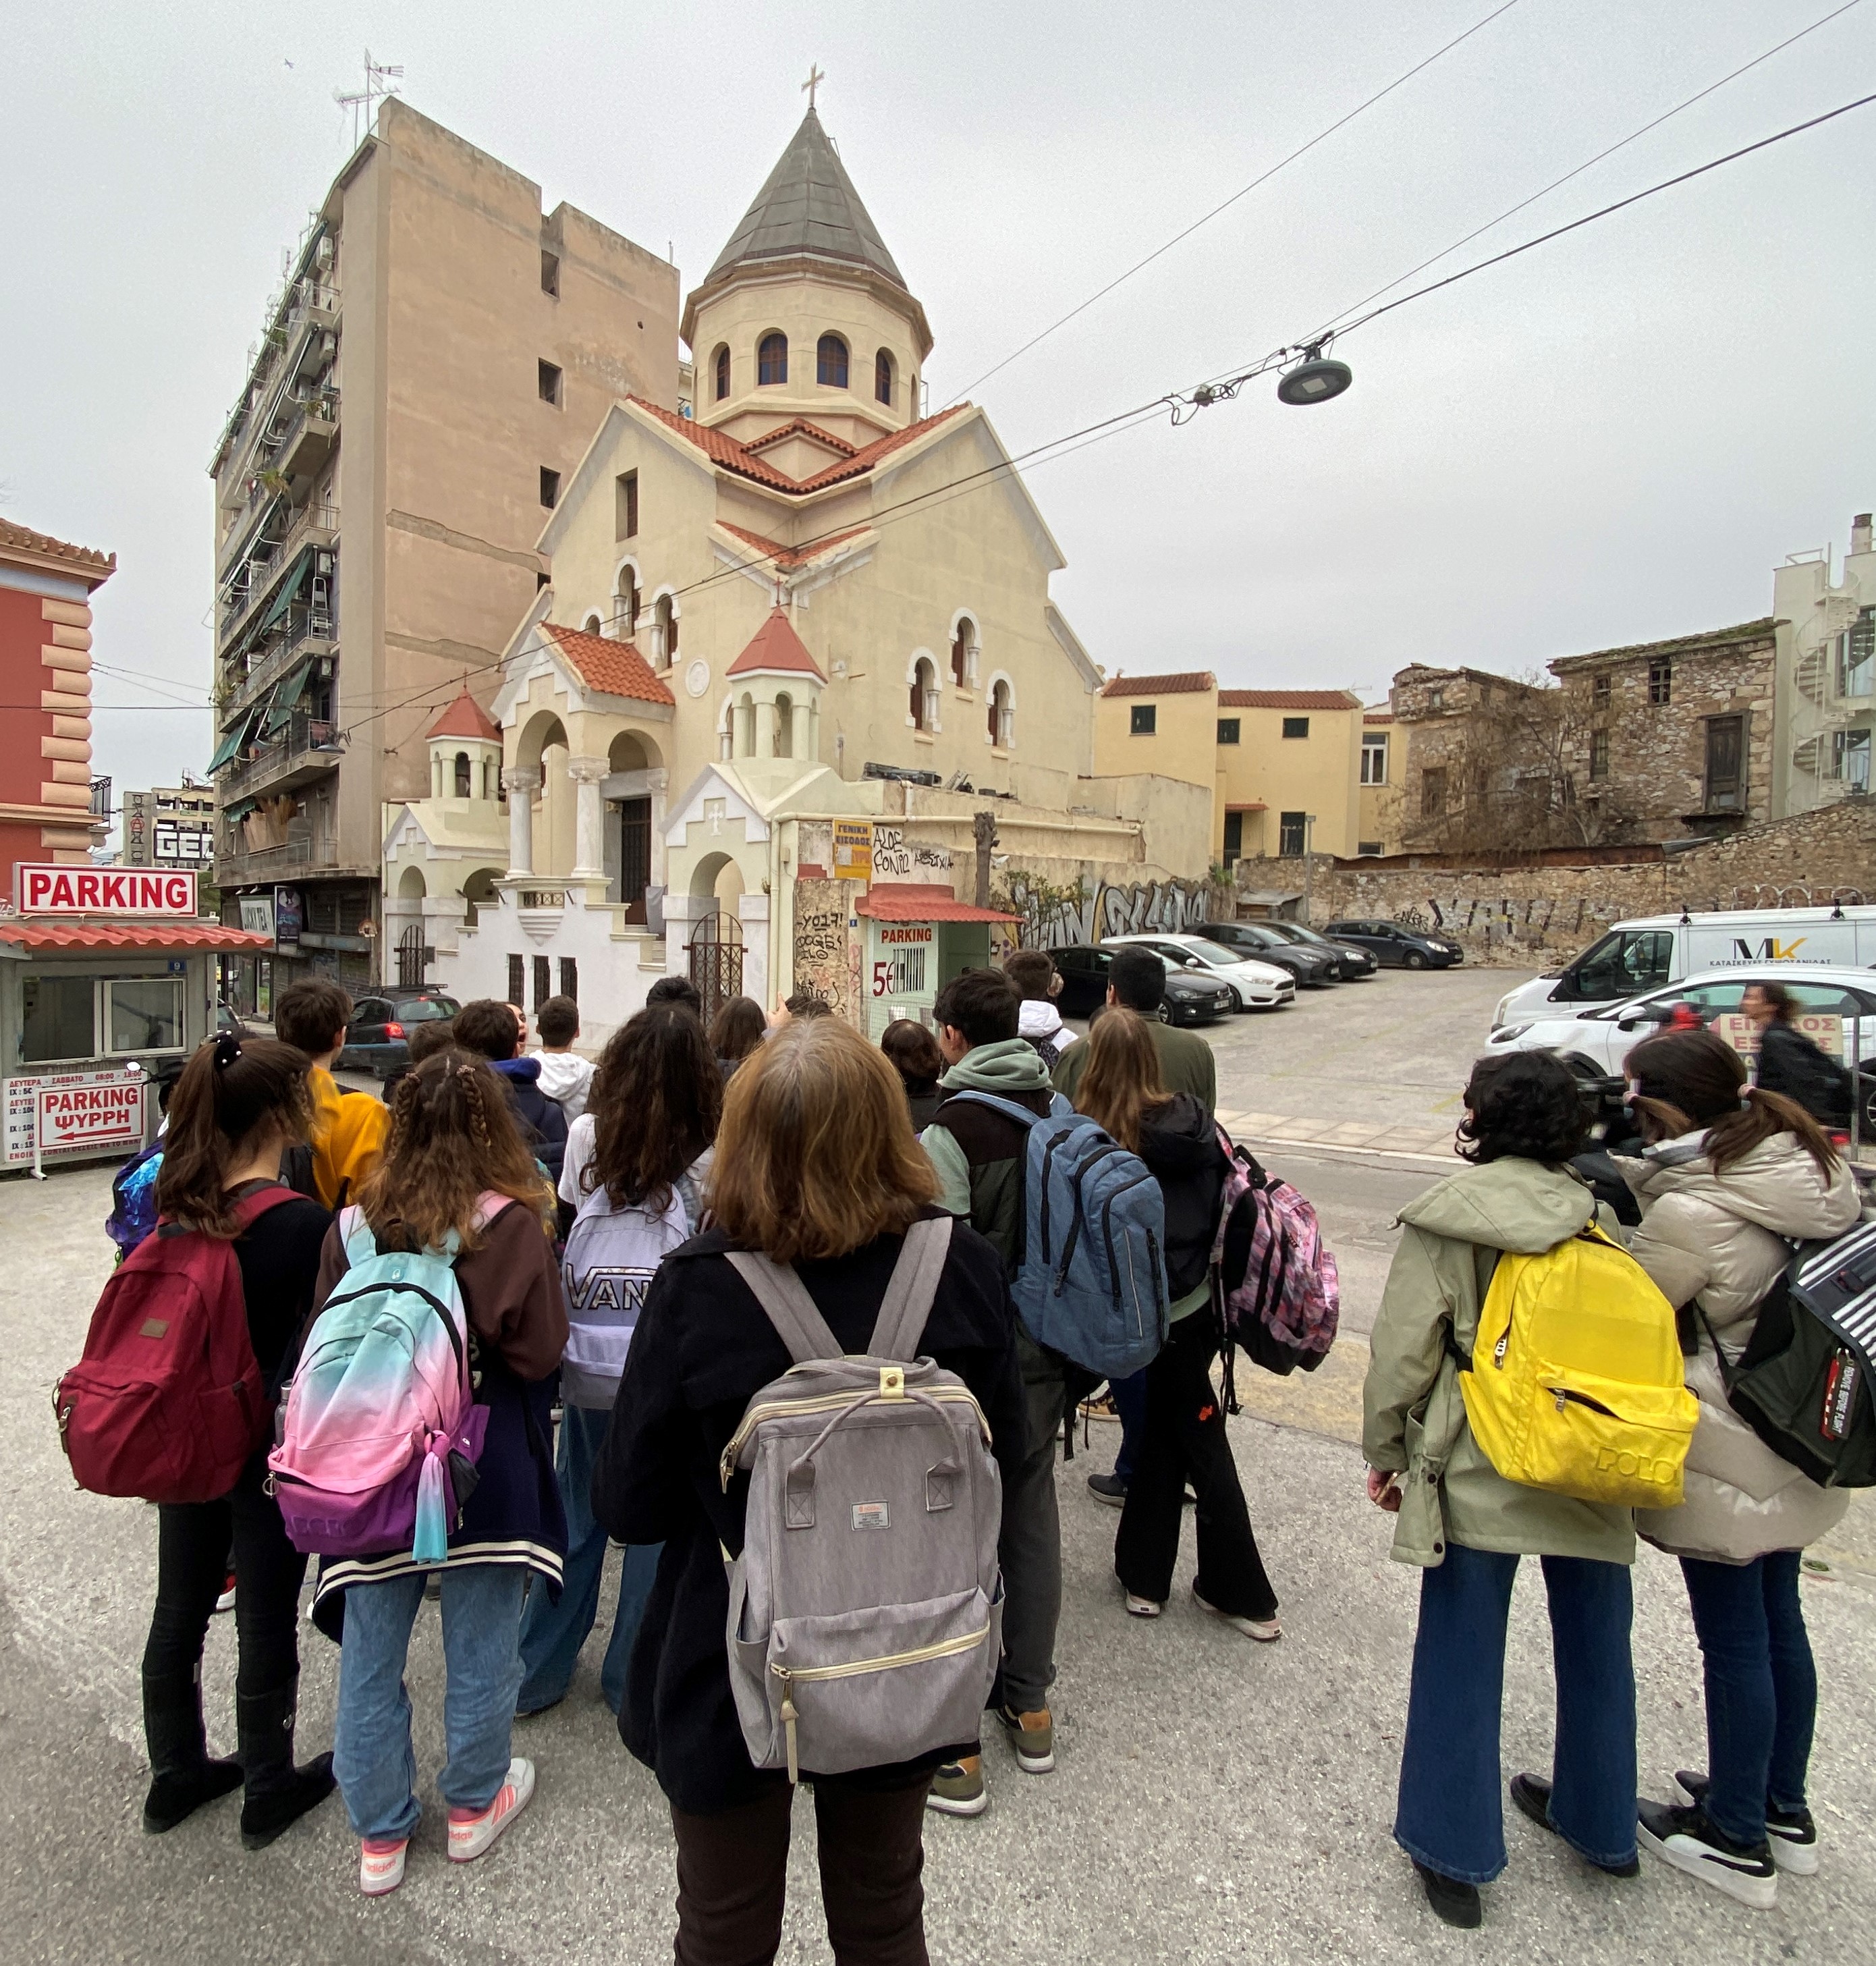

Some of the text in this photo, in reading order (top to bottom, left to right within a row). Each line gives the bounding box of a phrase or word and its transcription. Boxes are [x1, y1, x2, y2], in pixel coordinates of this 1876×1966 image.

[30, 873, 188, 908] PARKING
[881, 928, 932, 944] PARKING
[1729, 937, 1809, 959] MK
[873, 962, 894, 997] 5€
[1730, 1018, 1836, 1031] ΕΙΟΣ
[45, 1087, 138, 1114] PARKING
[55, 1109, 130, 1130] ΨΥΡΡΗ
[566, 1263, 658, 1309] VAN
[1595, 1446, 1677, 1485] POLO
[366, 1858, 396, 1874] adidas
